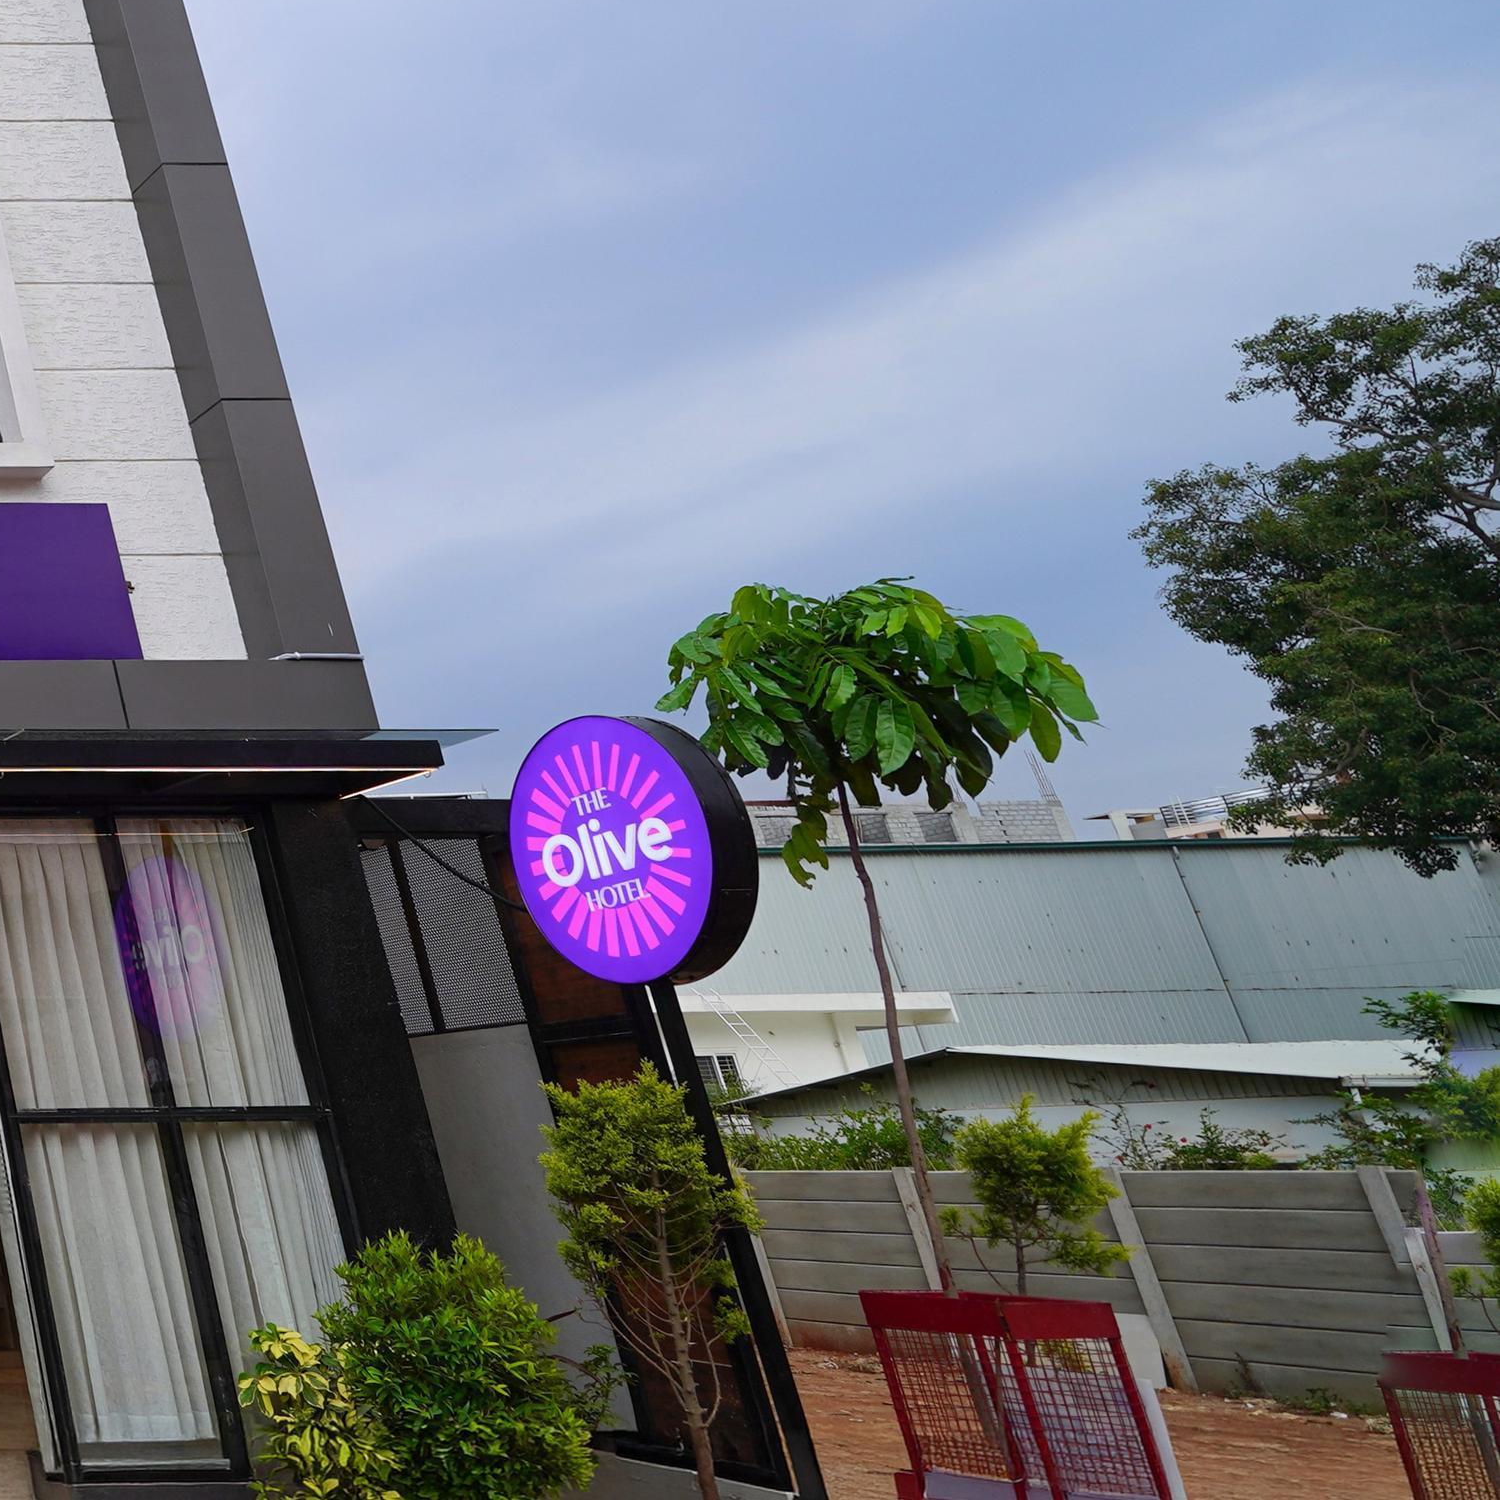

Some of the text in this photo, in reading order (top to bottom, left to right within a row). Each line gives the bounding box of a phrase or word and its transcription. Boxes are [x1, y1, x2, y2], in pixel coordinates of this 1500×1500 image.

[571, 787, 612, 816] THE
[542, 817, 673, 888] Olive
[585, 878, 651, 912] HOTEL
